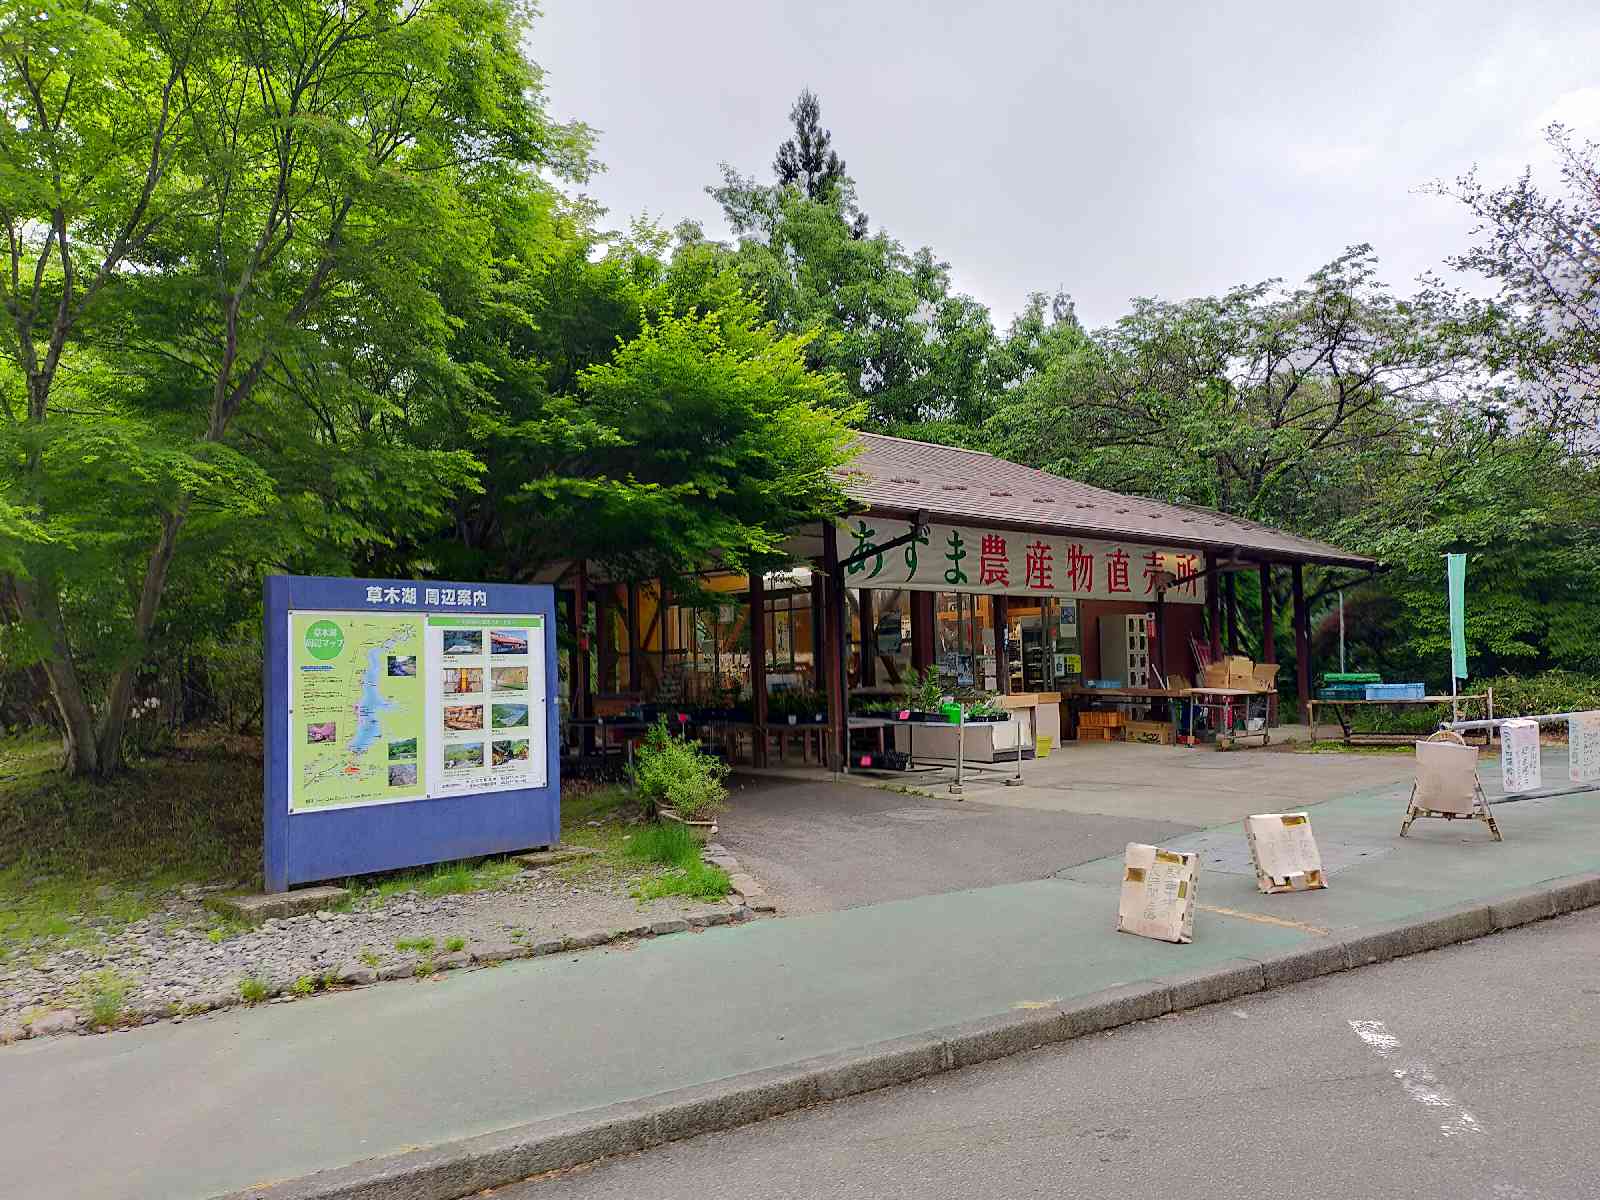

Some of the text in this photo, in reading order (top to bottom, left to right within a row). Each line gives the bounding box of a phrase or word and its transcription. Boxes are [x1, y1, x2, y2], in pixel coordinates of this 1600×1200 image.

[847, 519, 1199, 598] あずま農産物直売所
[366, 586, 487, 607] 草木湖 周辺案内
